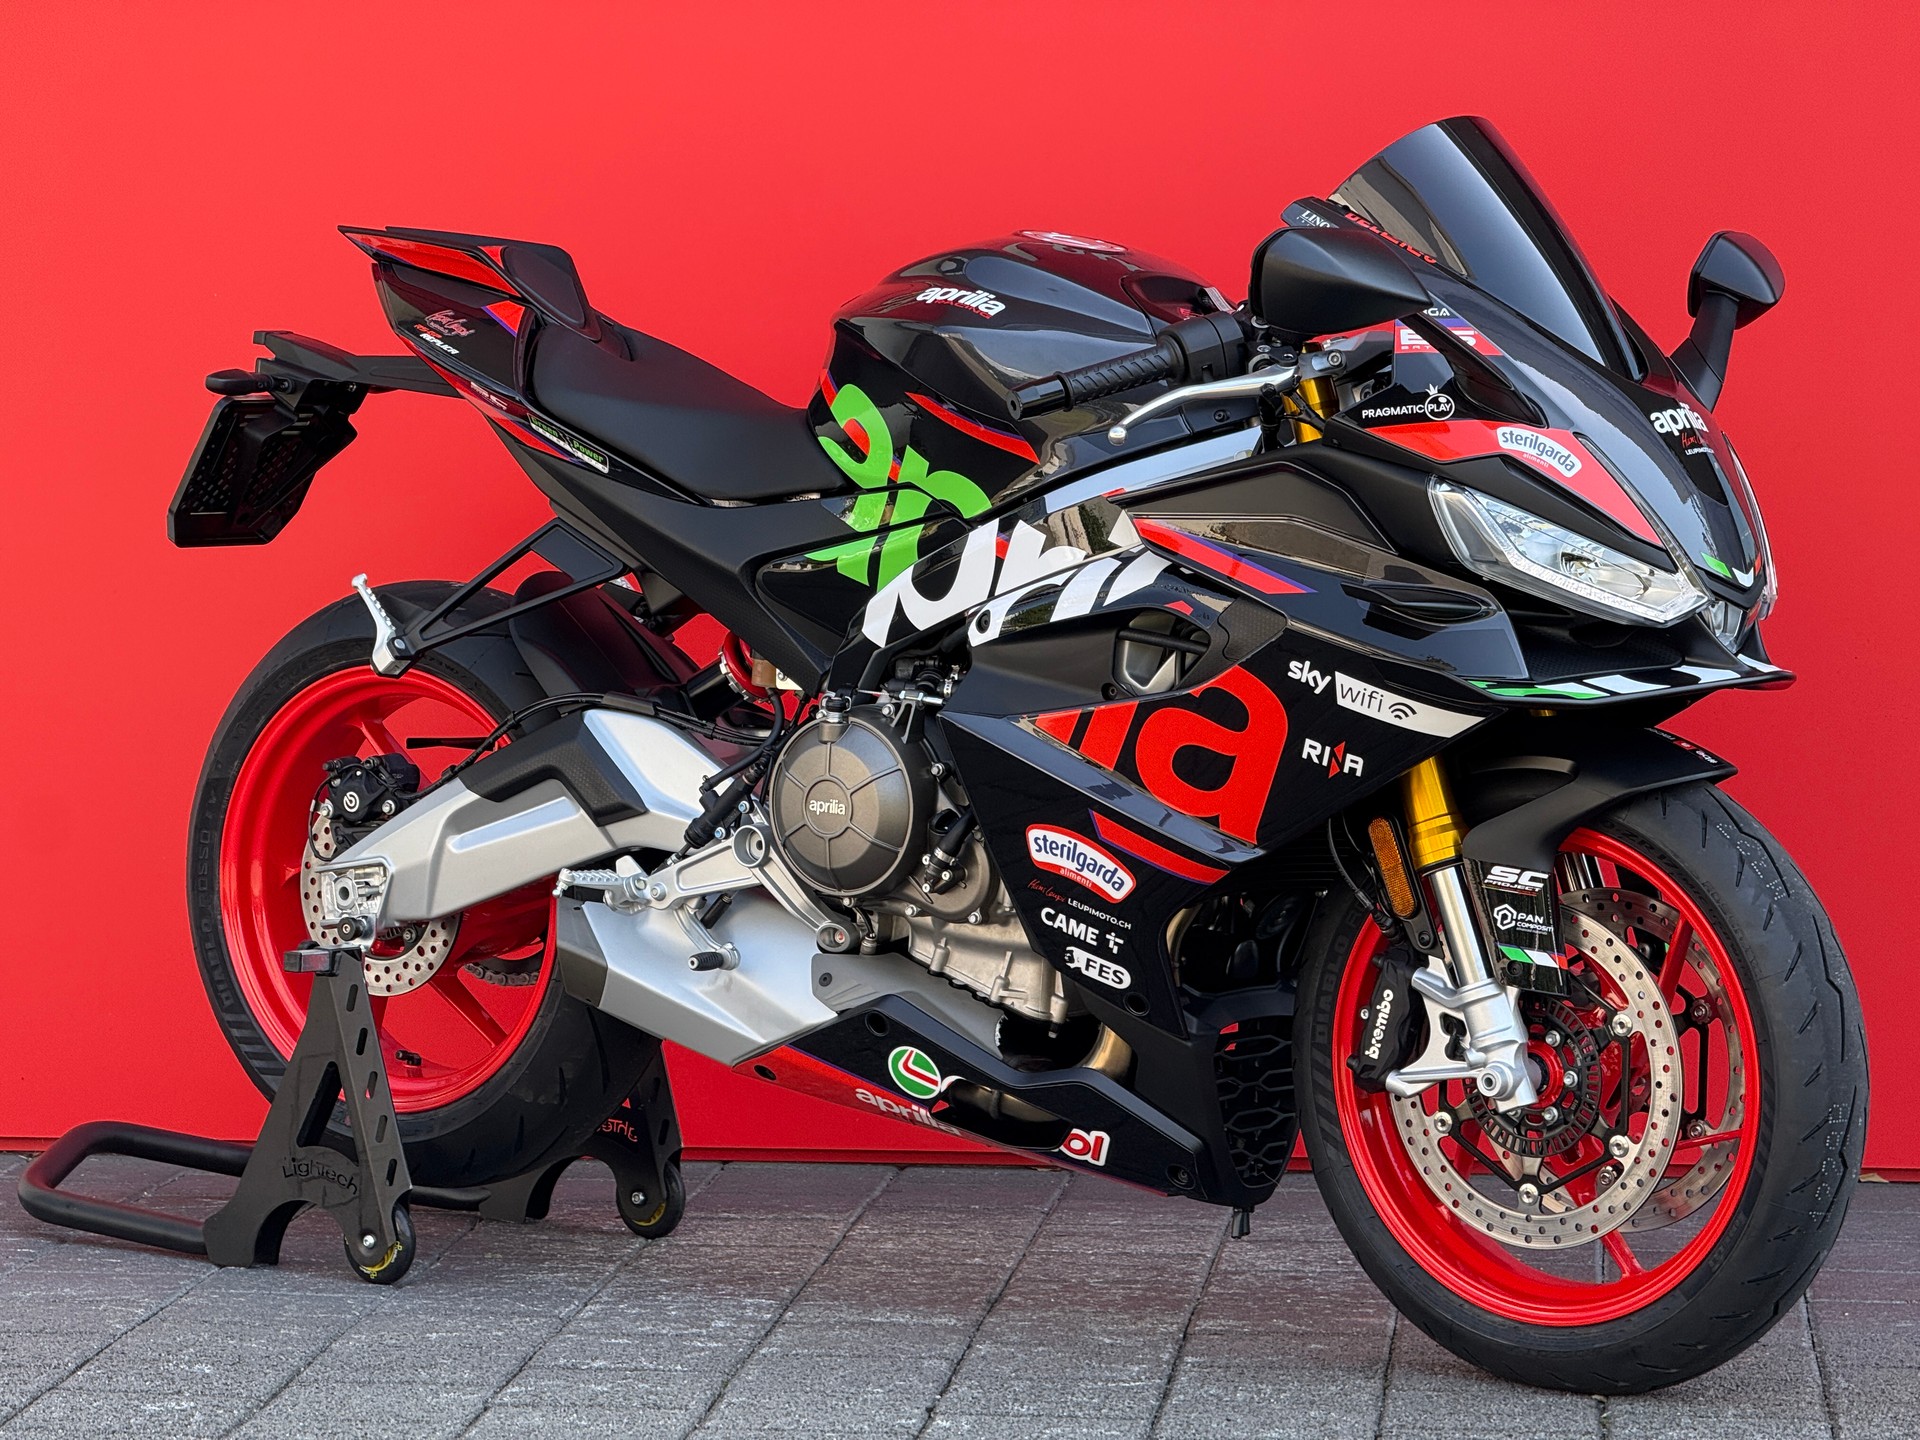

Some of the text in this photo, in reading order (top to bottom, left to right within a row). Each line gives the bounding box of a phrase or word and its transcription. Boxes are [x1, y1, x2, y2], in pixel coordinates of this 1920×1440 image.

[916, 287, 1006, 316] aprilia
[419, 333, 460, 355] REPLICA
[1362, 402, 1452, 420] PRAGMATIC PLAY
[572, 439, 604, 463] Power
[1501, 431, 1576, 472] sterilgarda
[1522, 453, 1549, 468] alimenti
[1287, 660, 1384, 713] sky wifi
[808, 799, 846, 816] aprilia
[1033, 834, 1125, 892] sterilgarda
[1059, 866, 1093, 888] alimenti
[1484, 879, 1542, 892] PROJECT
[1486, 865, 1549, 889] SC
[1040, 907, 1100, 946] CAME
[1067, 897, 1132, 930] LEUPIMOTO.CH
[1517, 912, 1544, 924] PAN
[1084, 957, 1125, 985] FES
[1364, 989, 1394, 1060] brembo
[854, 1088, 963, 1136] aprilia
